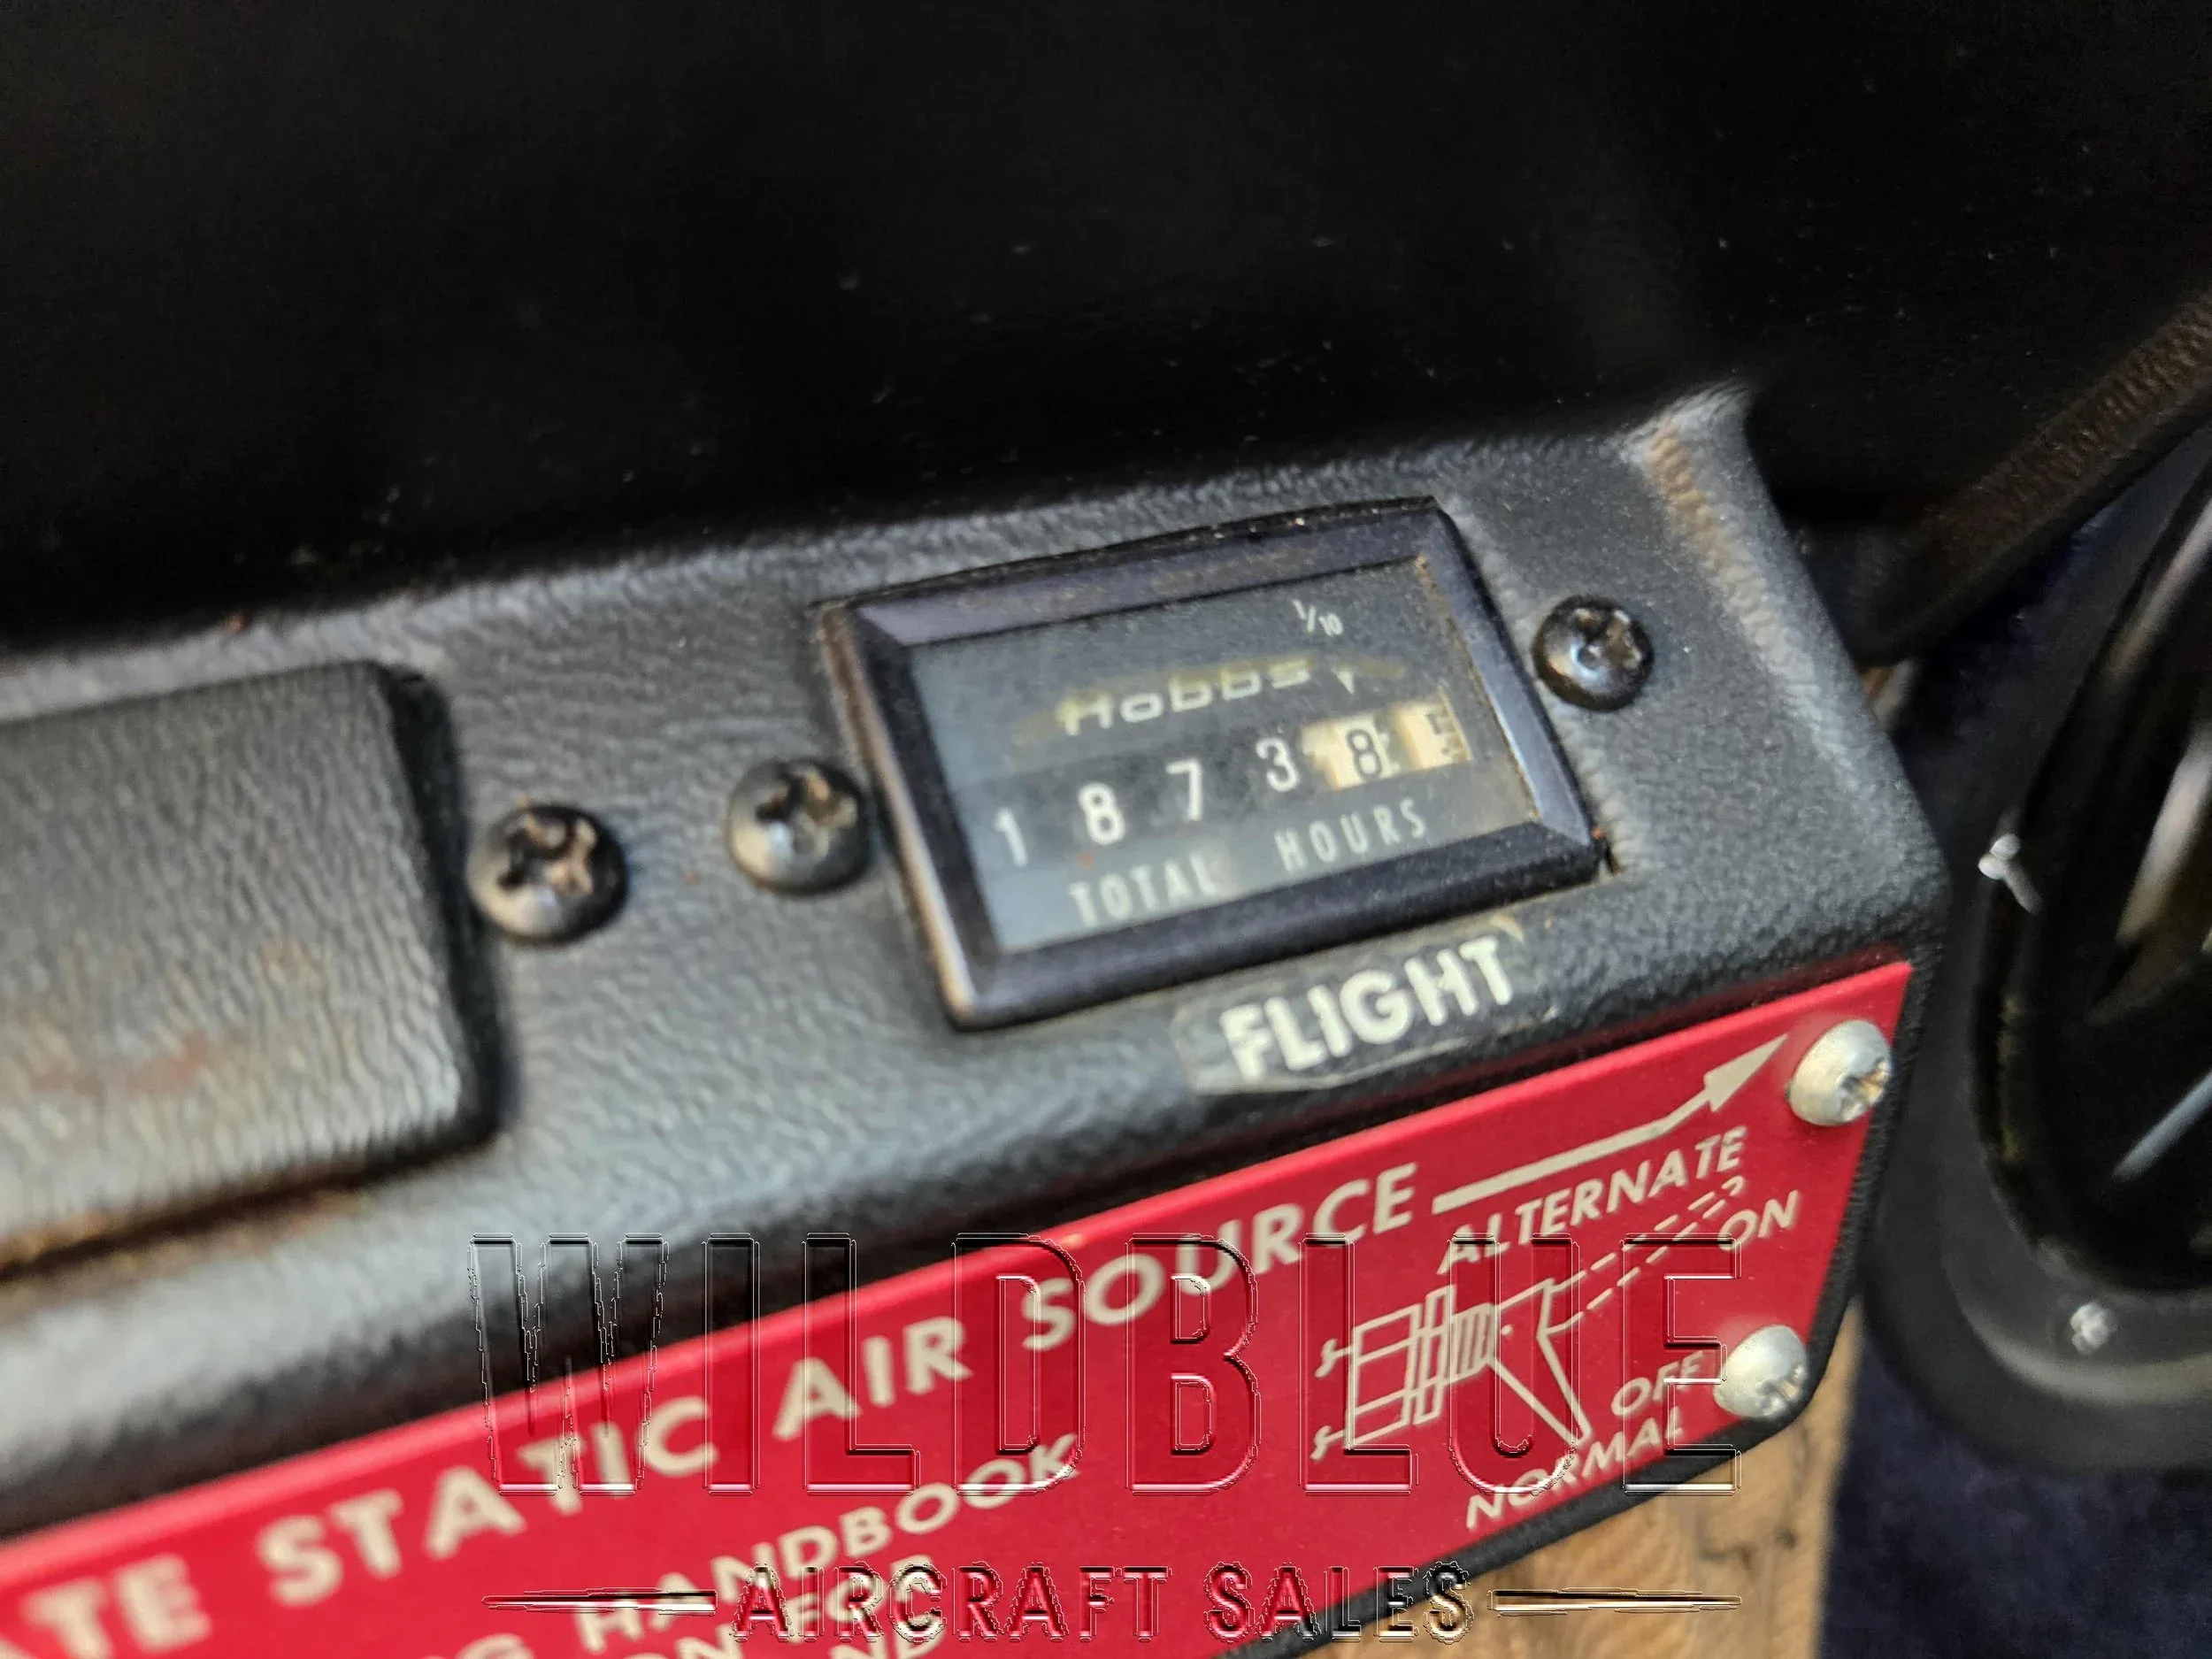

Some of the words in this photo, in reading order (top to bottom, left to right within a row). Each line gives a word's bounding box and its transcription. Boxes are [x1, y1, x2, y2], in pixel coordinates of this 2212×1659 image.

[1062, 659, 1312, 737] Hobbs
[1070, 855, 1220, 927] TOTAL
[1274, 804, 1425, 872] HOURS
[1220, 935, 1514, 1080] FLIGHT
[1438, 1126, 1747, 1274] ALTERNATE
[1717, 1190, 1801, 1251] ON
[257, 1395, 718, 1608] STATIC
[772, 1316, 972, 1440] AIR
[1022, 1163, 1419, 1351] SOURCE
[1610, 1352, 1704, 1417] OFF
[1465, 1407, 1685, 1530] NORMAL
[573, 1432, 1079, 1651] HANDBOOK
